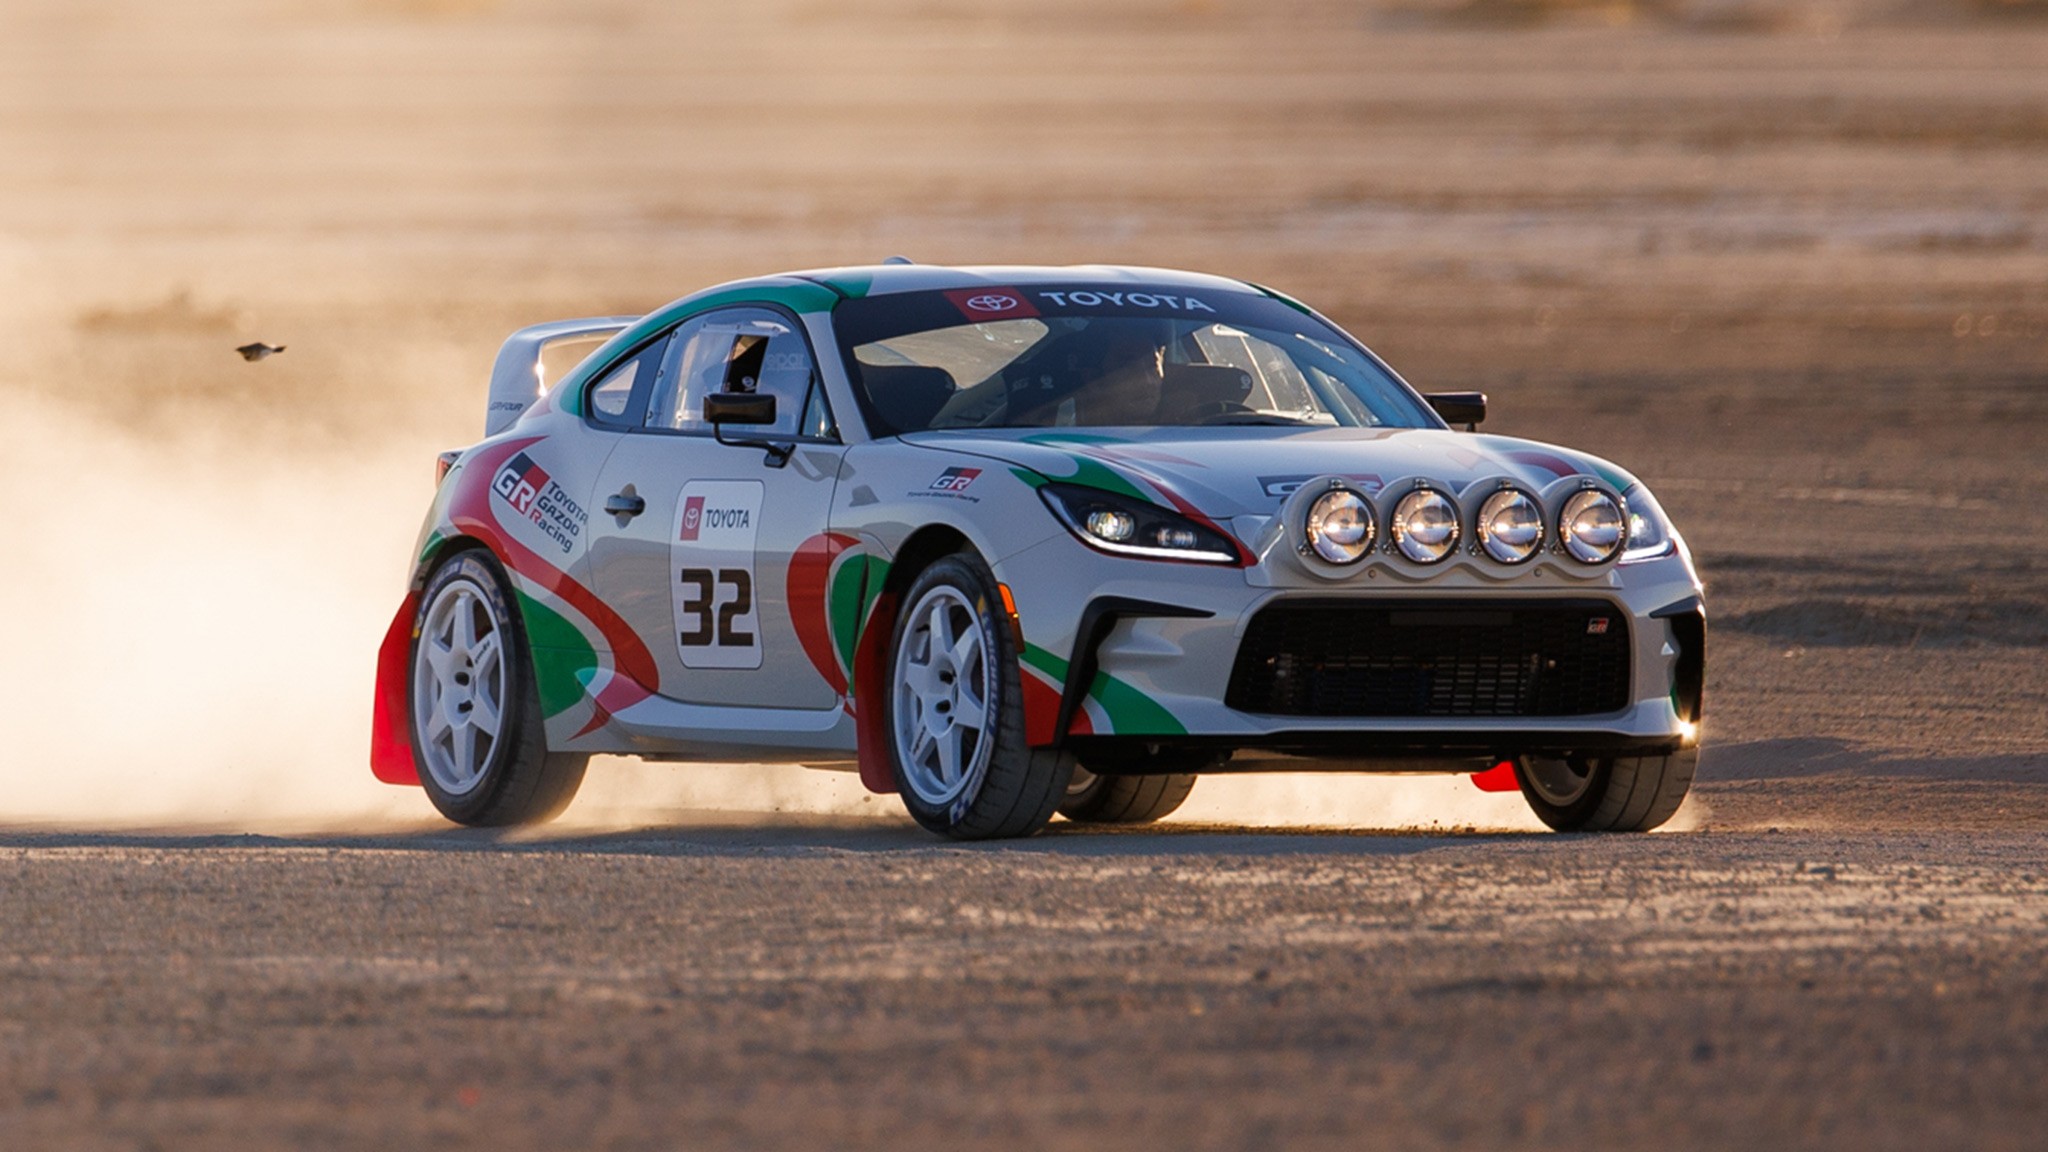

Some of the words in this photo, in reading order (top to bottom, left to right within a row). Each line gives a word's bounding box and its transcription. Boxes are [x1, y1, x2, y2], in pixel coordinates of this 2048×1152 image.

[1039, 291, 1217, 314] TOYOTA
[494, 467, 537, 513] GR
[548, 480, 589, 525] TOYOTA
[932, 476, 972, 490] GR
[529, 508, 573, 554] Racing
[537, 496, 581, 537] GAZOO
[706, 509, 749, 528] TOYOTA
[681, 568, 754, 647] 32
